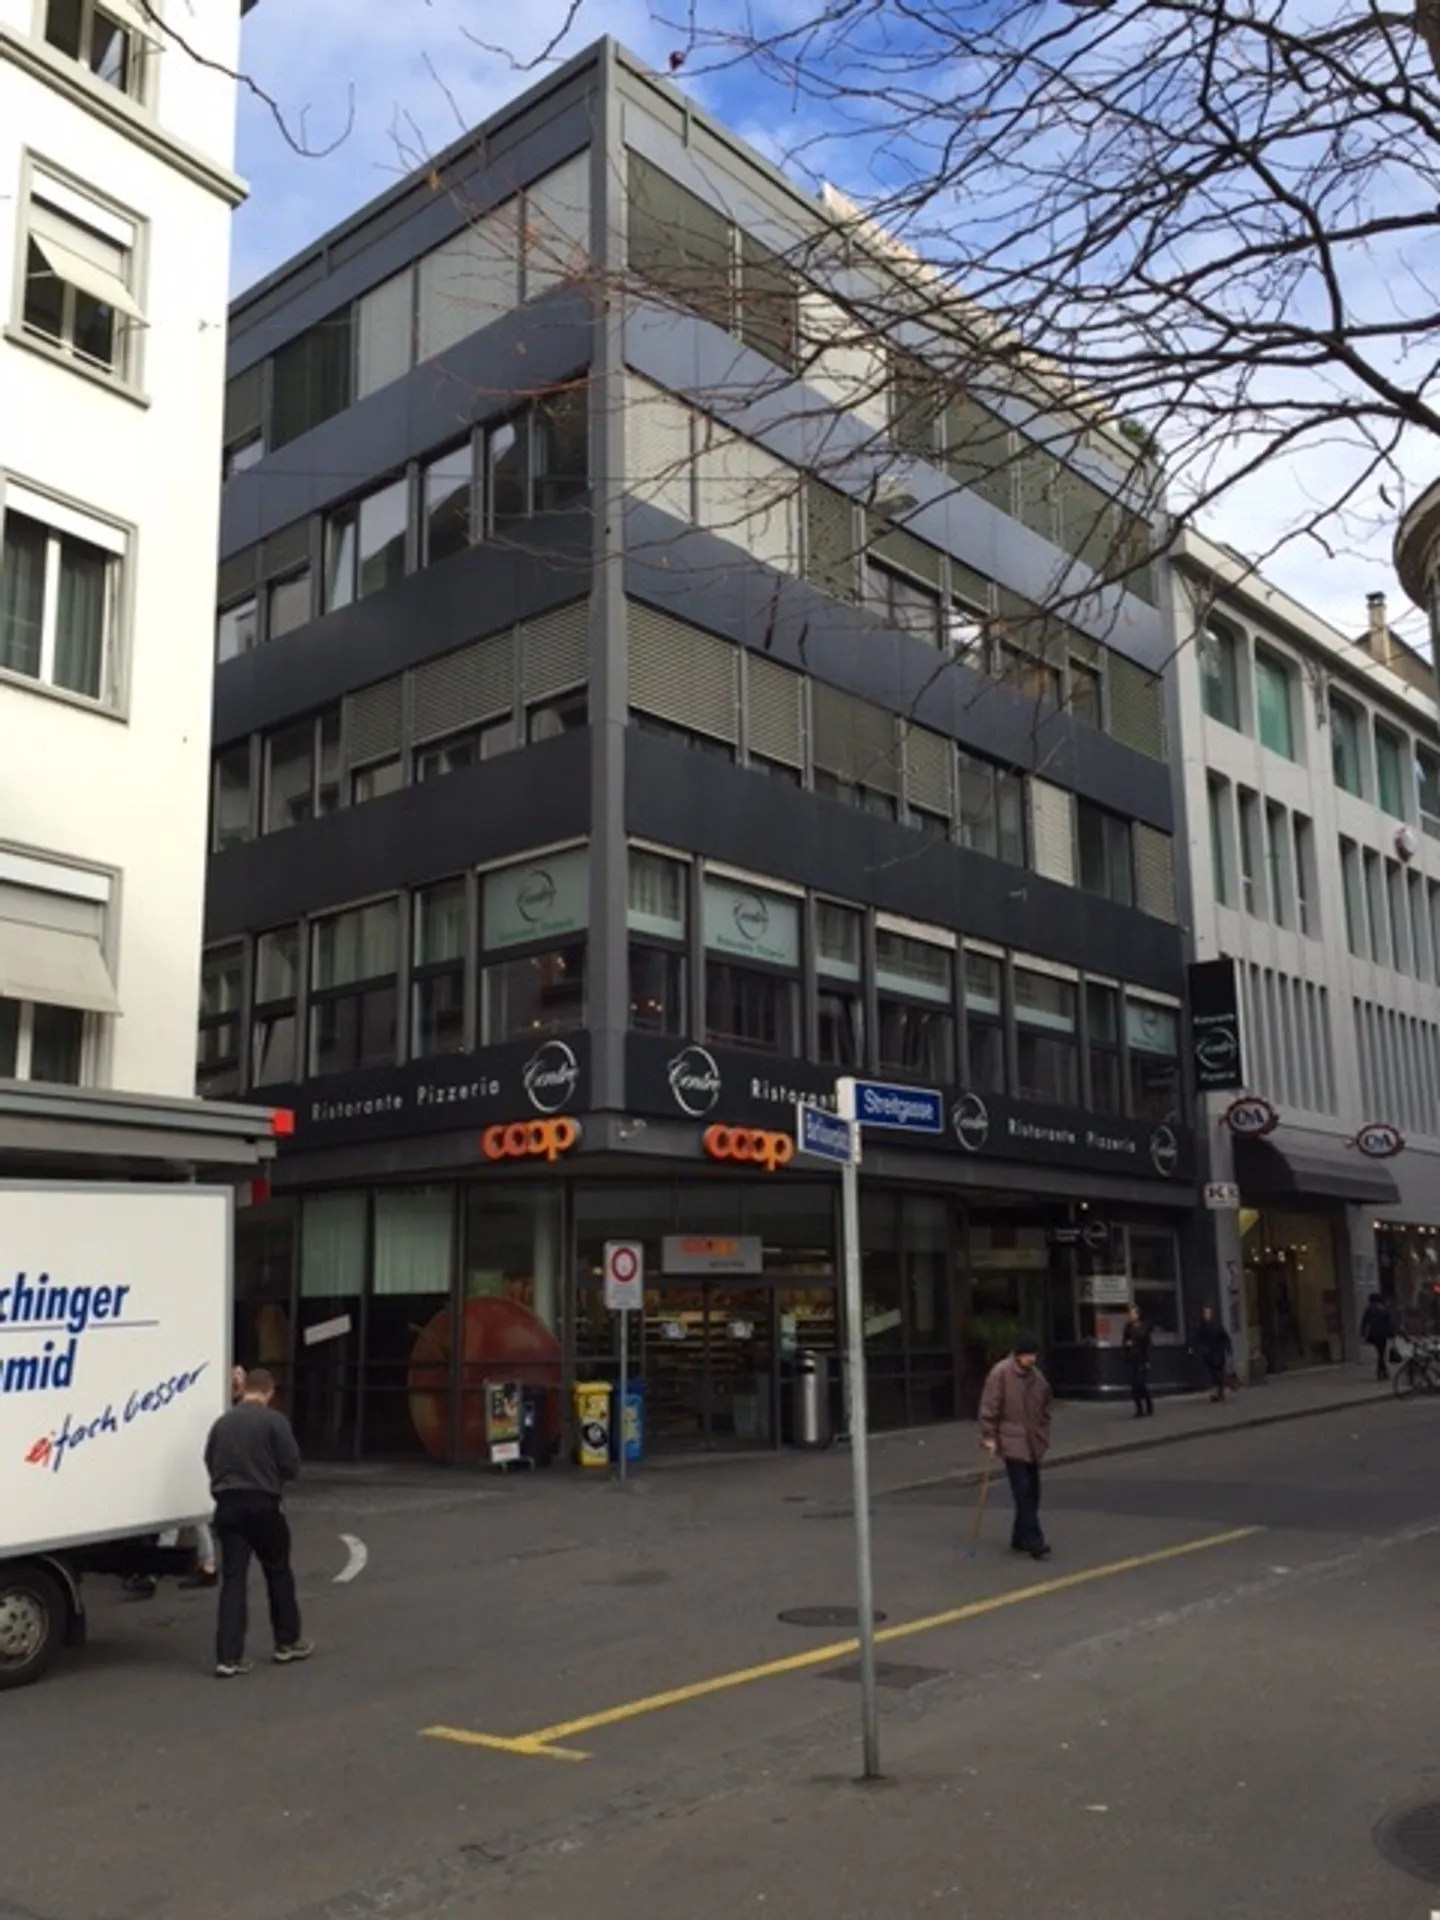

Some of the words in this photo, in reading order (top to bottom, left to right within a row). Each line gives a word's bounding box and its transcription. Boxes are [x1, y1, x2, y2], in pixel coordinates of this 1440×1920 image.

[312, 1094, 403, 1121] Ristorante
[417, 1076, 501, 1105] Pizzeria
[750, 1077, 837, 1107] Ristorant
[482, 1117, 579, 1161] coop
[702, 1123, 795, 1172] coop
[1008, 1117, 1076, 1144] Ristorante
[0, 1338, 77, 1393] mid
[123, 1361, 210, 1423] besser
